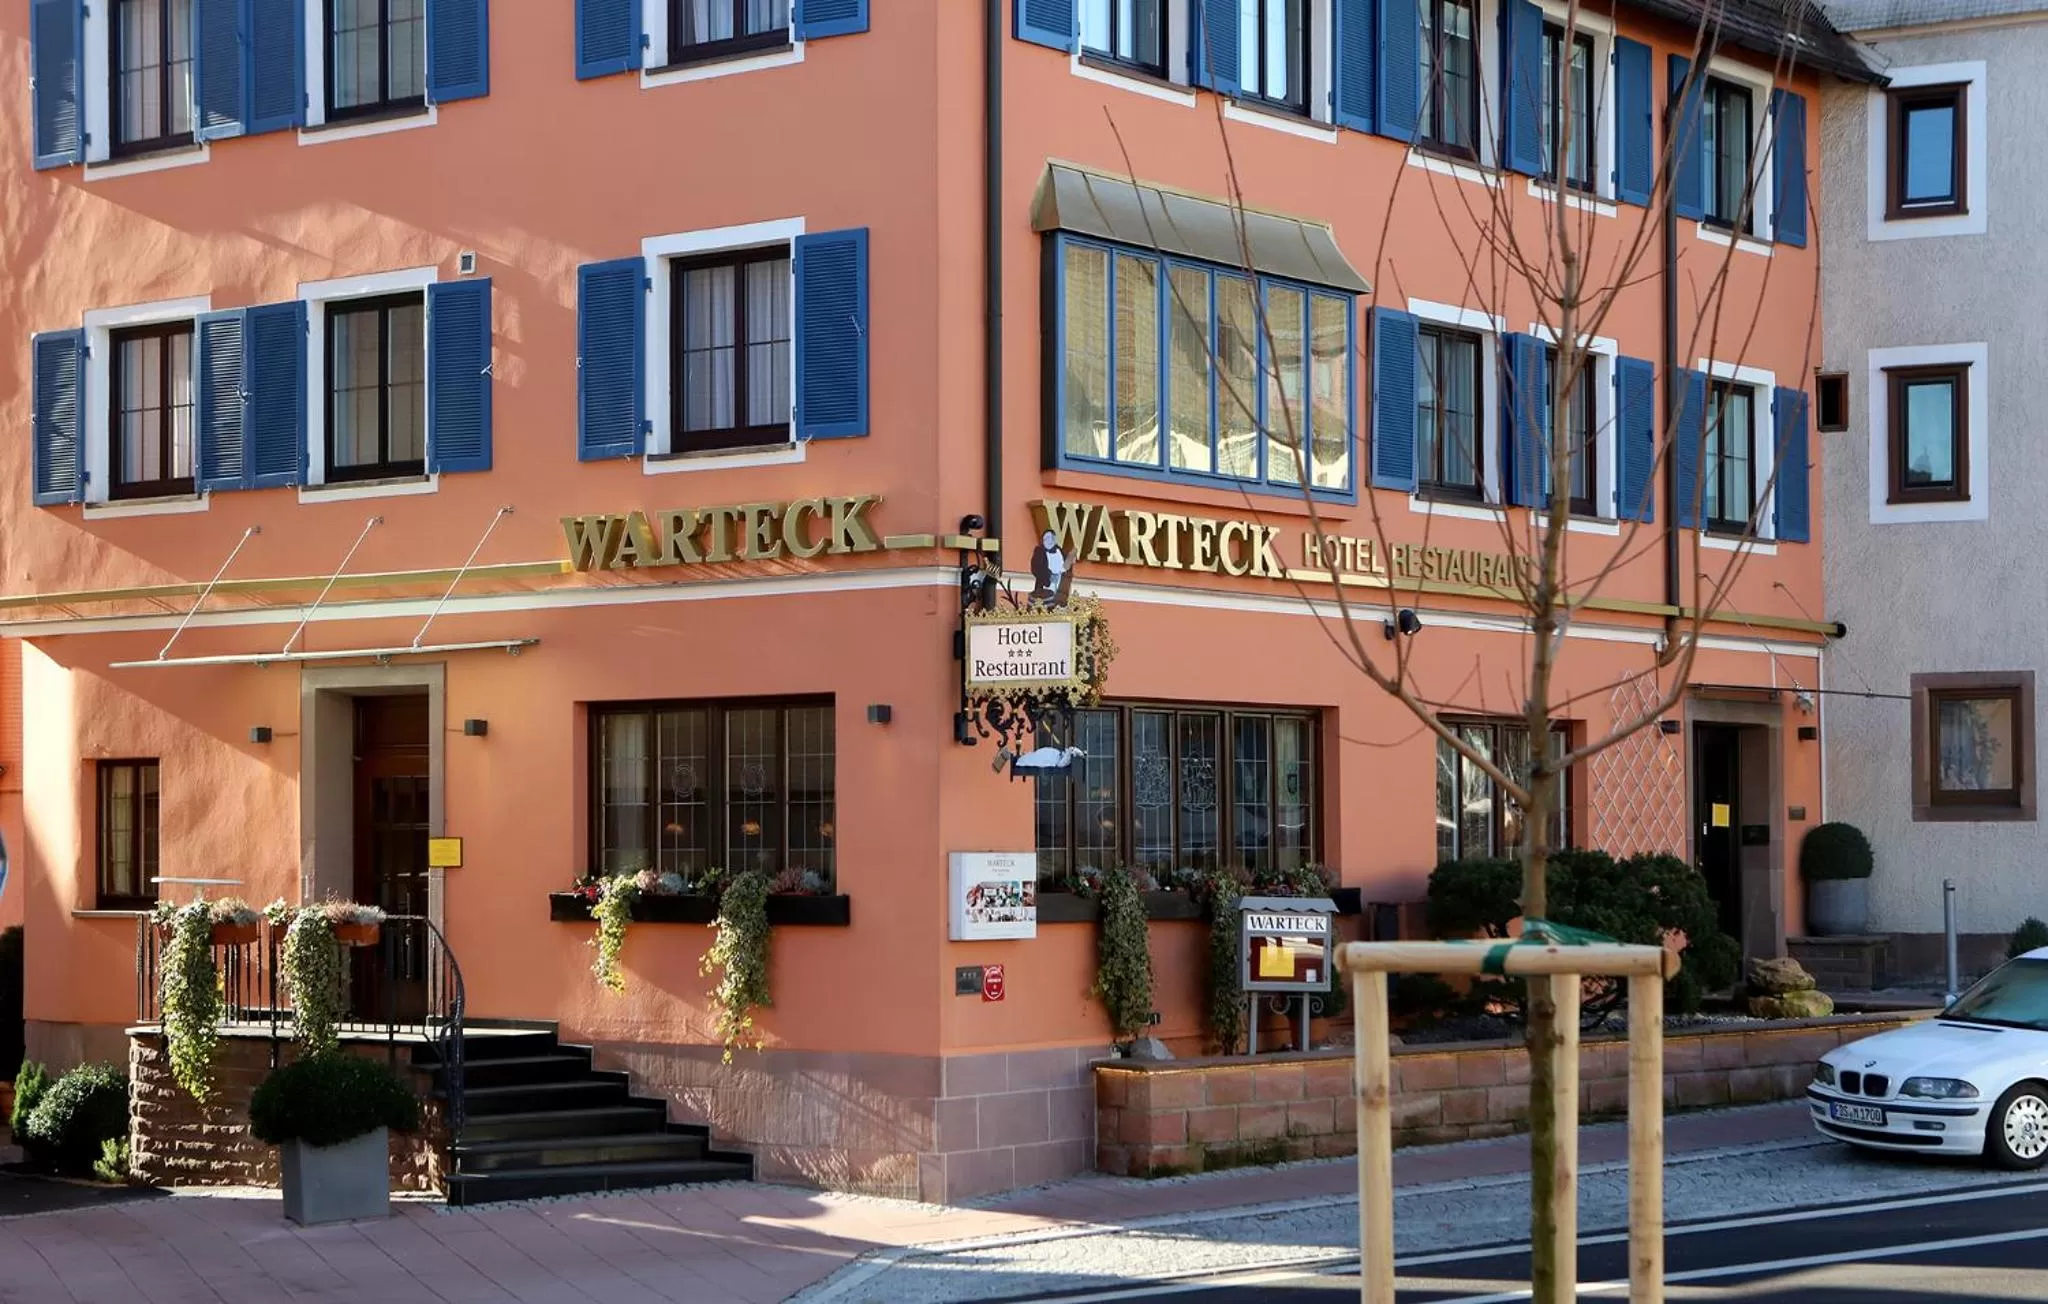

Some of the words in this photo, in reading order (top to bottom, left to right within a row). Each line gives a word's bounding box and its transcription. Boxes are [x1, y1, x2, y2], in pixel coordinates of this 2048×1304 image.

[560, 494, 883, 572] WARTECK
[1035, 499, 1285, 578] WARTECK
[1302, 532, 1384, 574] HOTEL
[998, 626, 1043, 645] Hotel
[975, 659, 1066, 677] Restaurant
[1249, 916, 1326, 931] WARTECK
